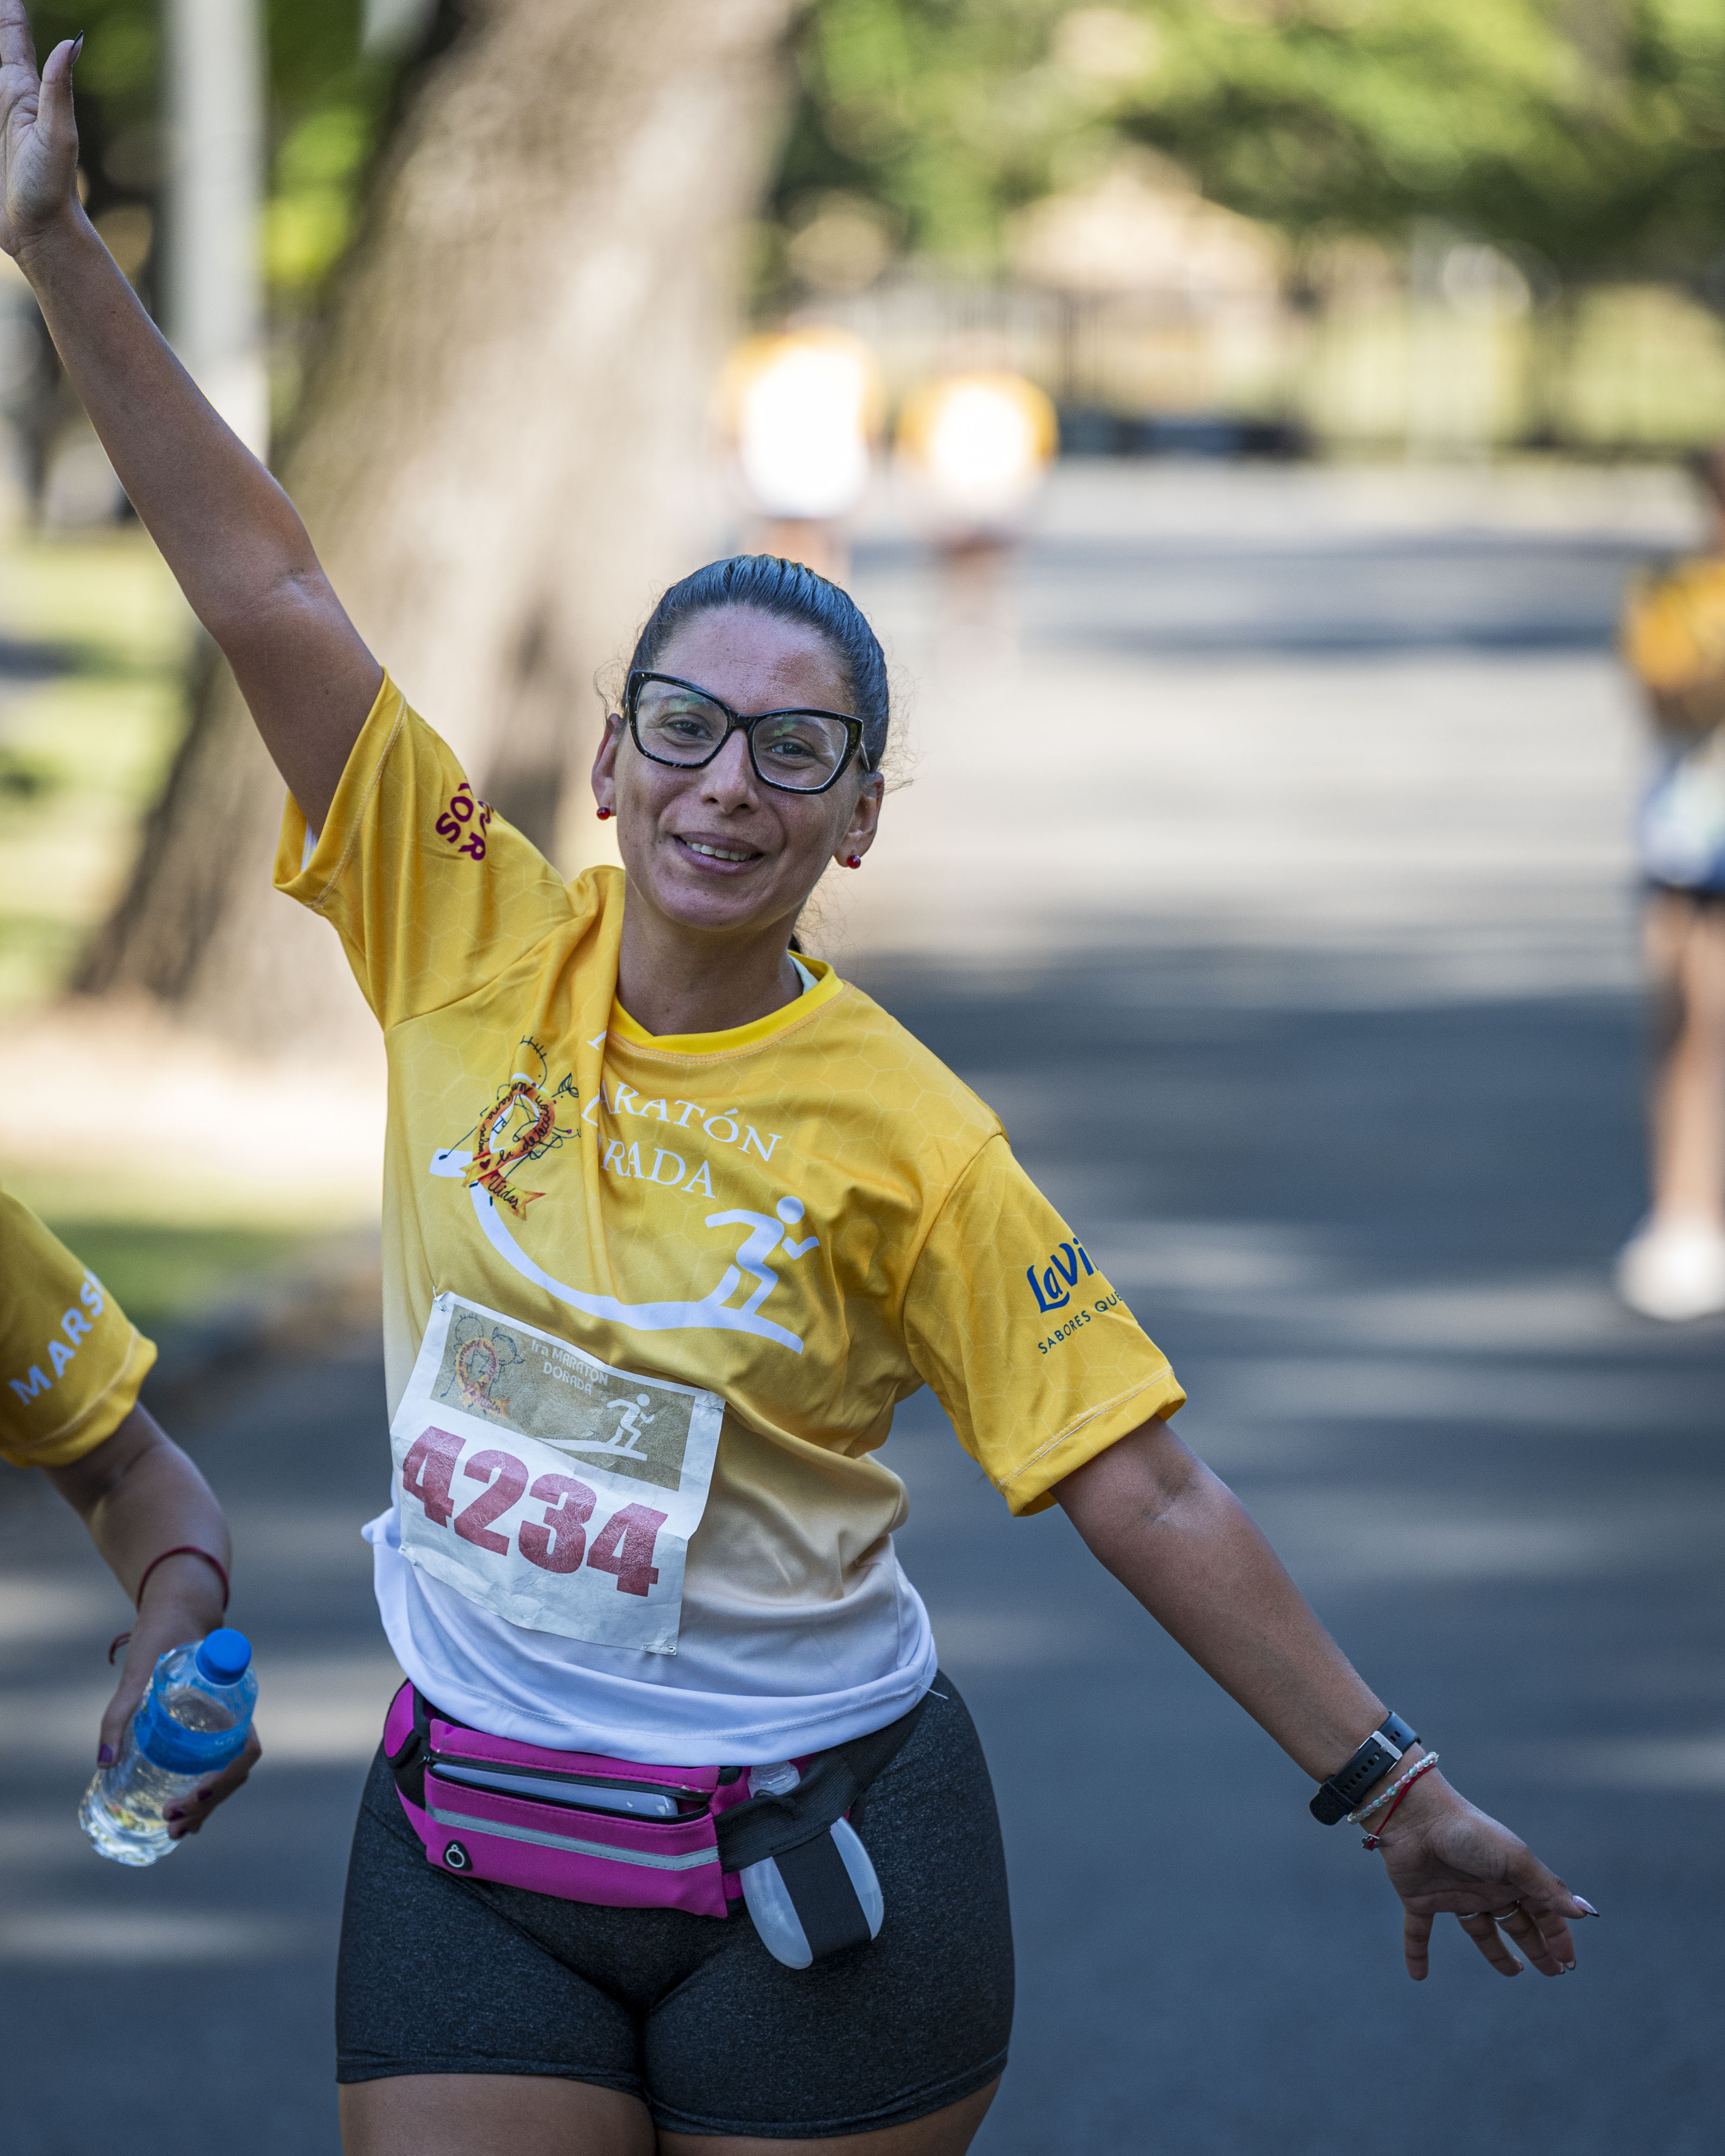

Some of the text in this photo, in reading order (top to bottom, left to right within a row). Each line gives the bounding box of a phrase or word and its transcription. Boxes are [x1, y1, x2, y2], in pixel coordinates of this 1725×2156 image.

[1038, 1310, 1091, 1354] SABORES
[543, 1360, 594, 1396] DORADA
[403, 1426, 669, 1597] 4234
